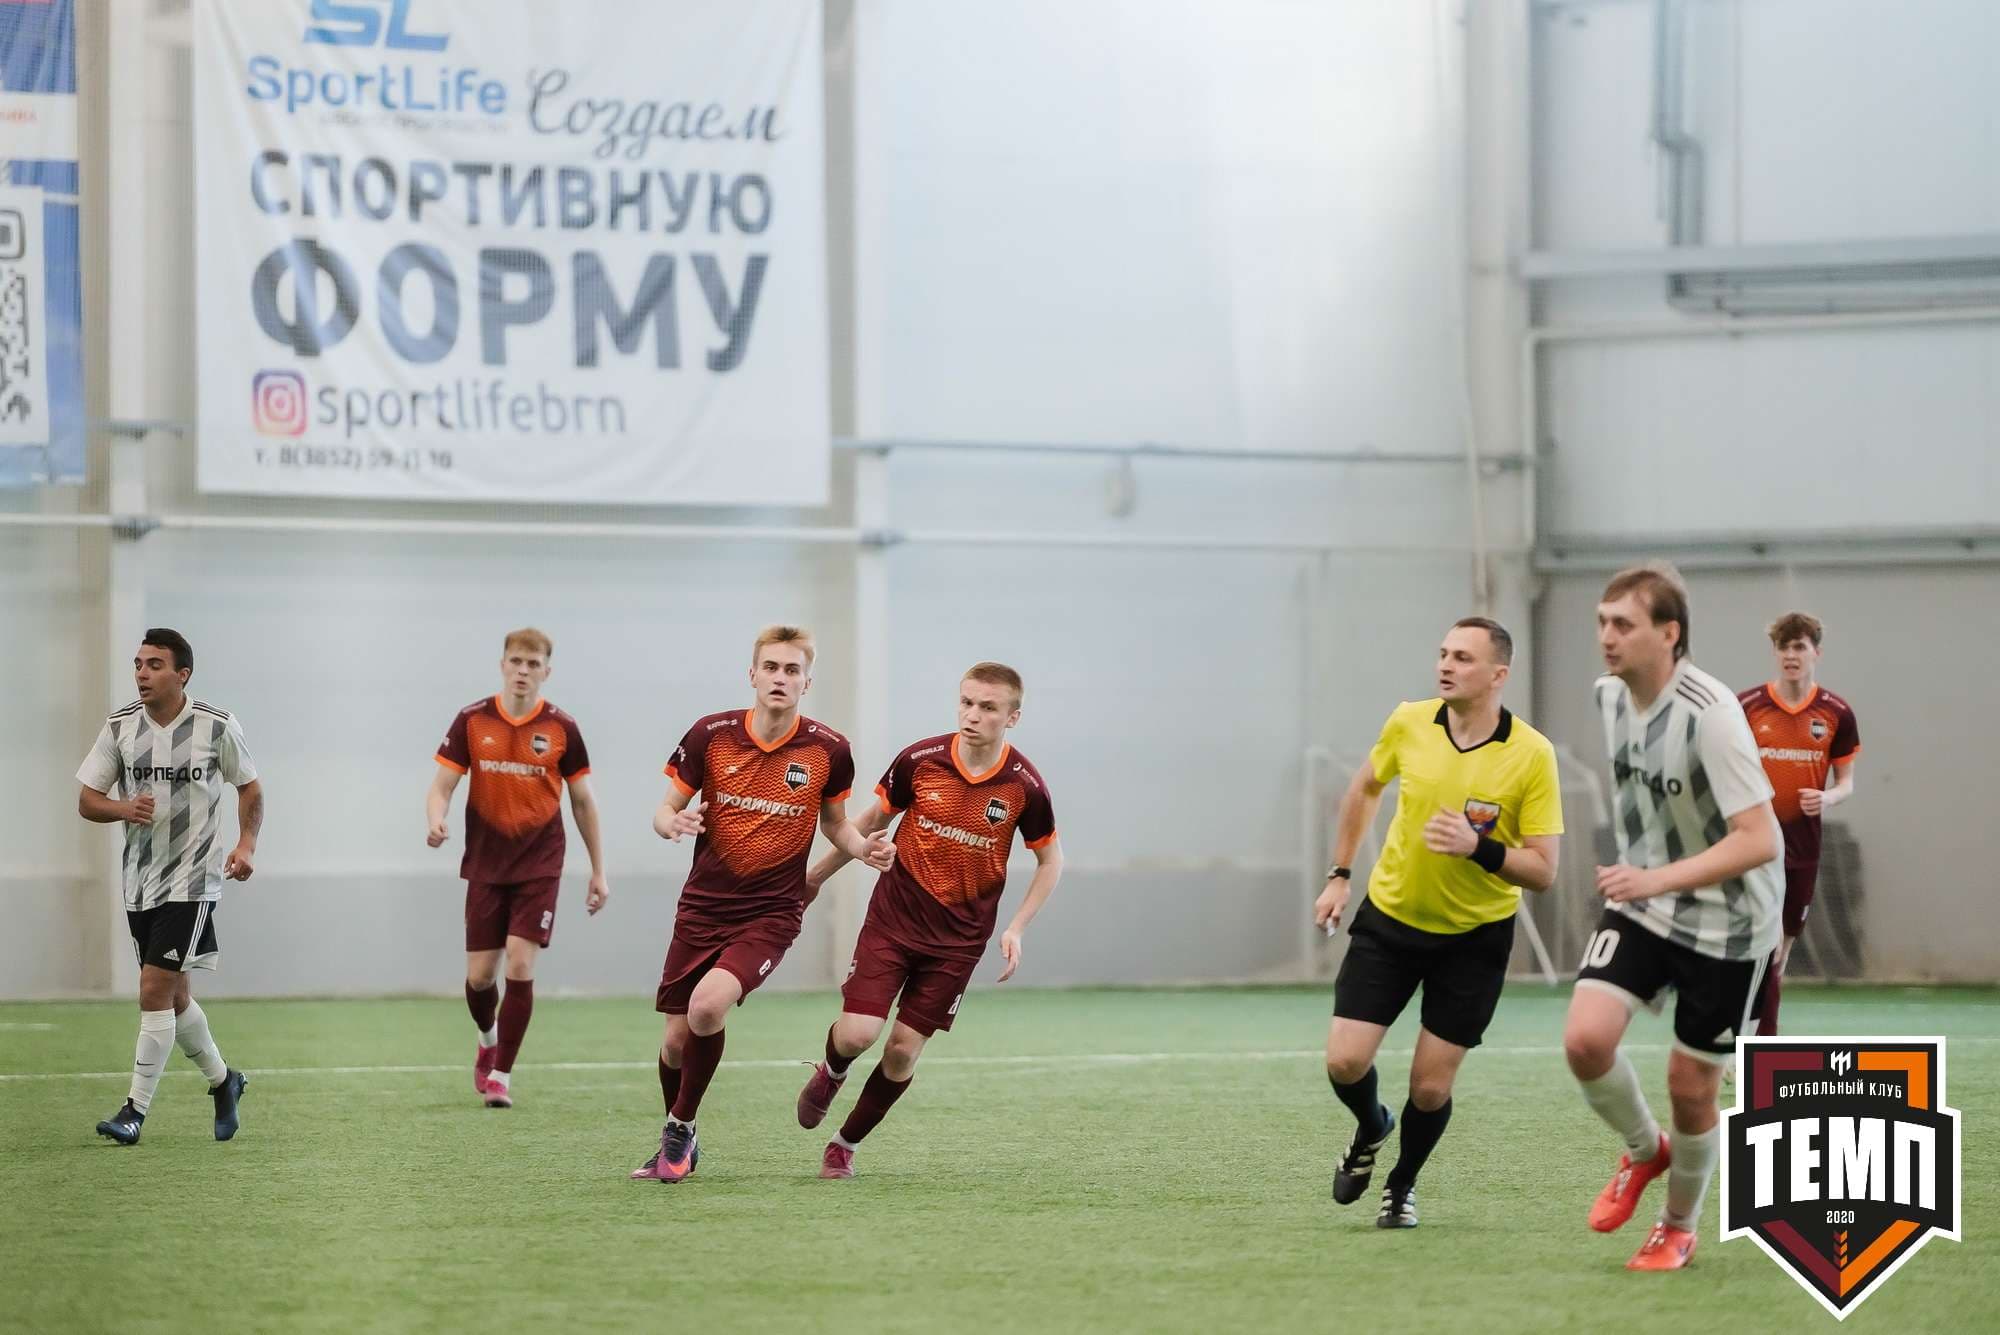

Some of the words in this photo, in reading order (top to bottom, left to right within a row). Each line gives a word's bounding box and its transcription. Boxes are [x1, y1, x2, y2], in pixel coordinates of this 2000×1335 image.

[247, 55, 508, 114] SportLife
[526, 68, 786, 161] Создаем
[250, 149, 774, 236] СПОРТИВНУЮ
[251, 238, 770, 373] ФОРМУ
[317, 379, 627, 437] sportlifebrn
[127, 766, 203, 783] ТОРПЕДО
